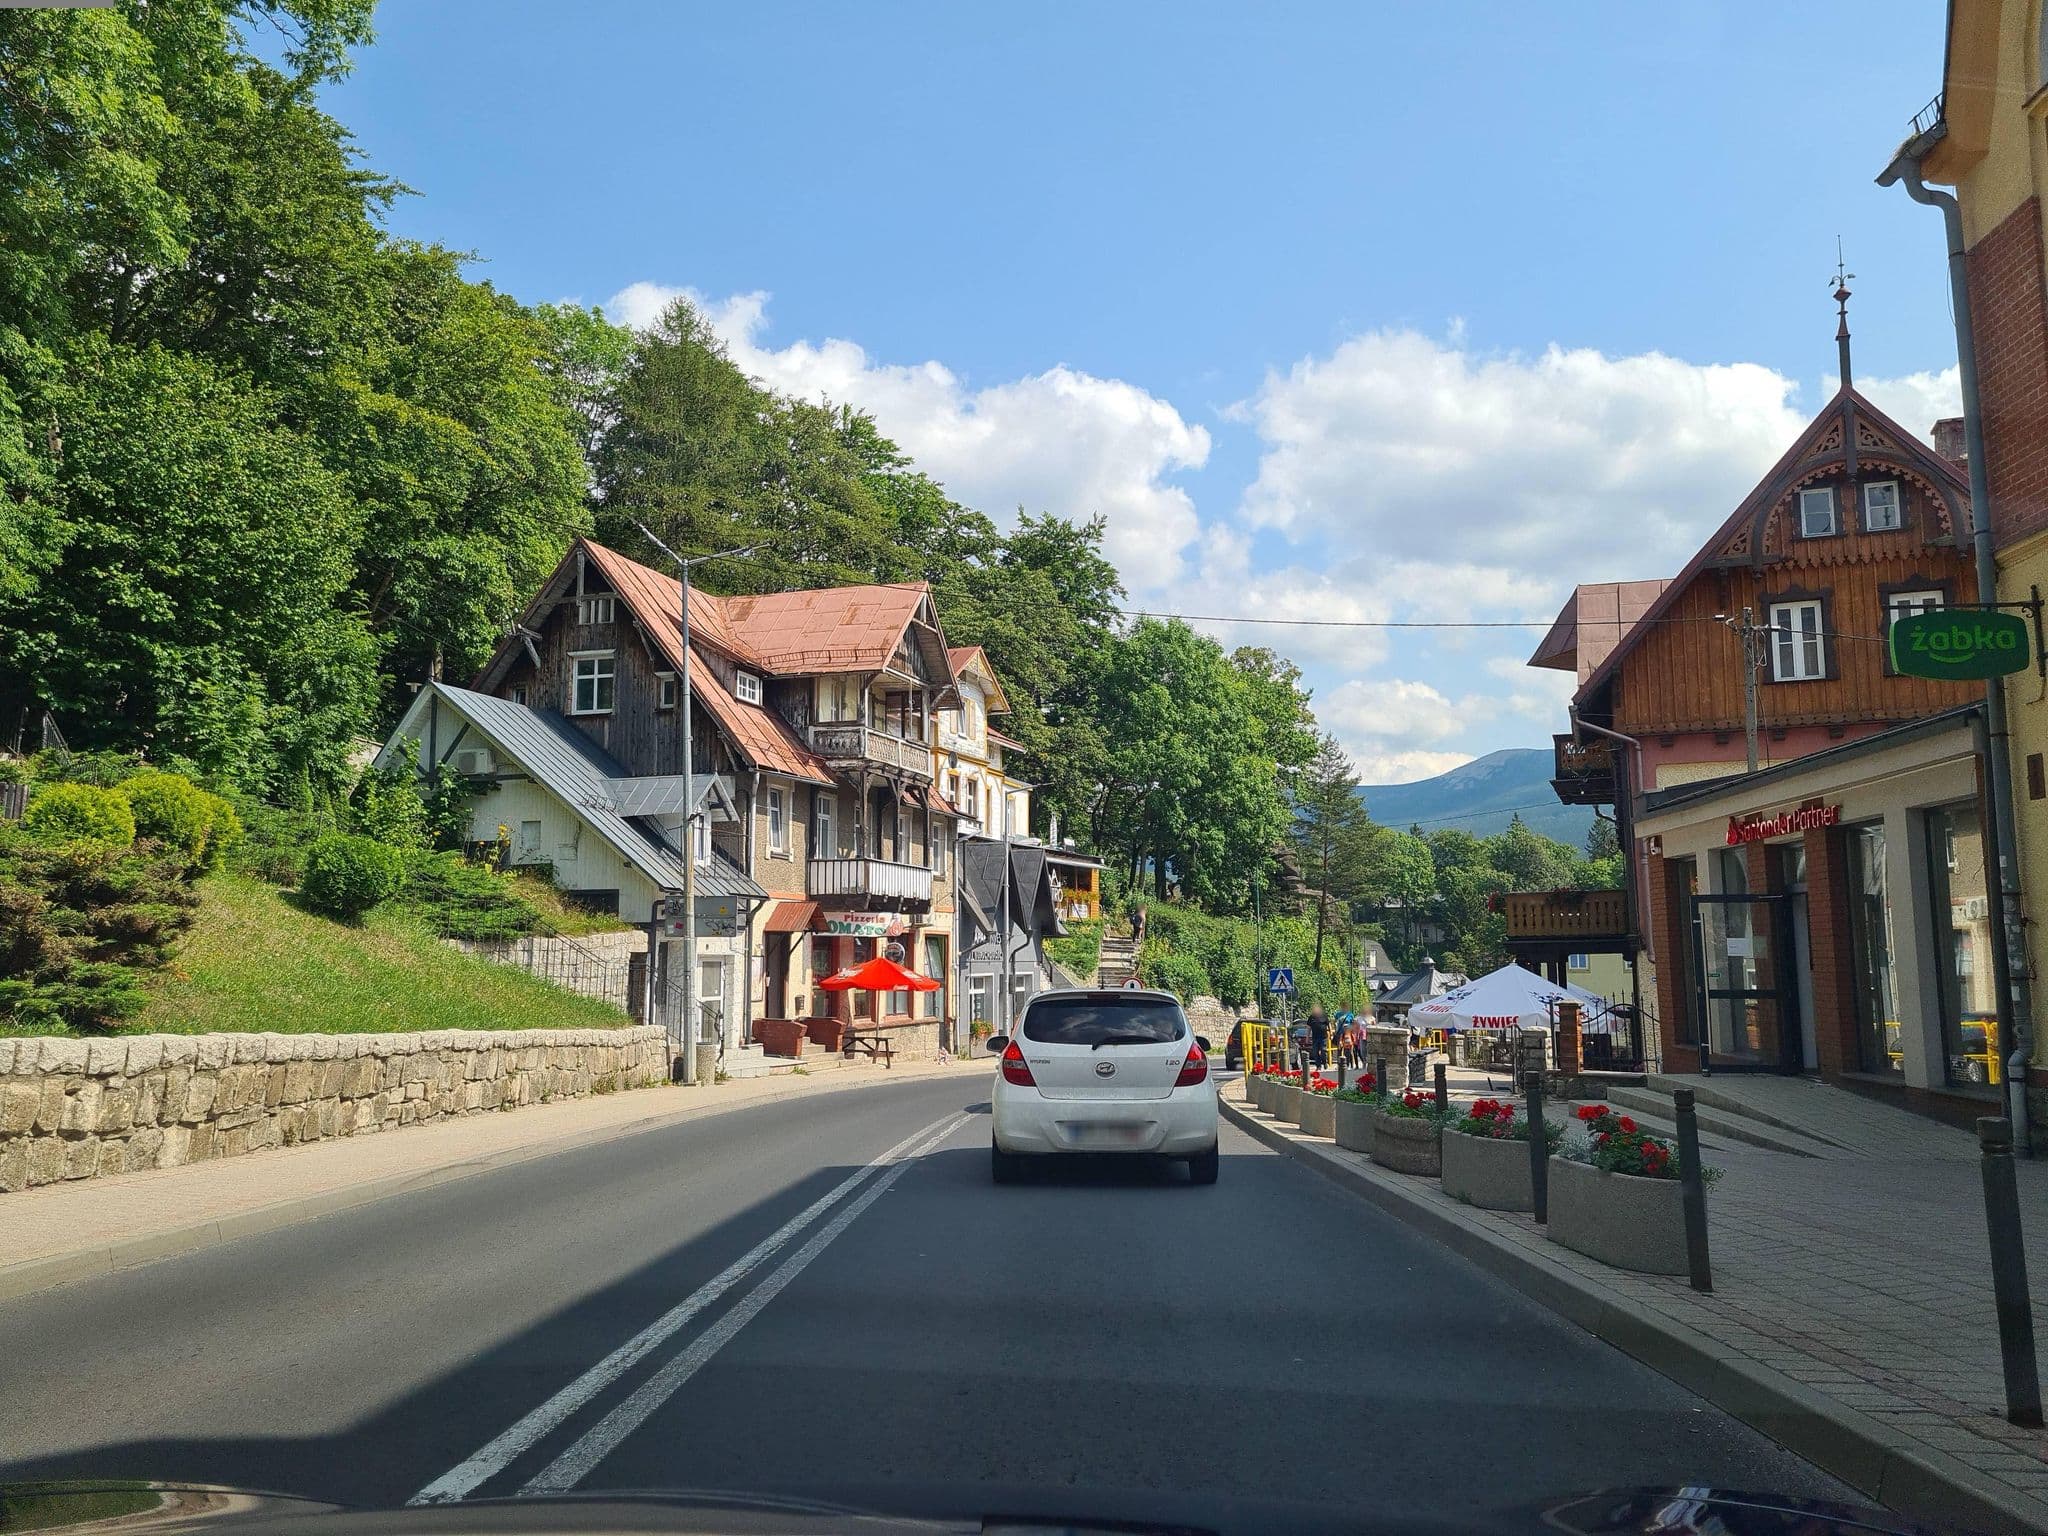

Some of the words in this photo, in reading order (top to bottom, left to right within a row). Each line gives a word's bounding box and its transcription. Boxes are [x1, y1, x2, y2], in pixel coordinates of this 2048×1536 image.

[1911, 625, 2017, 650] żabka
[1740, 811, 1792, 842] Santander
[1793, 804, 1840, 832] Partner
[844, 912, 886, 924] Pizzeria
[827, 920, 887, 935] OMATO
[1472, 1015, 1520, 1029] ŻYWIEC
